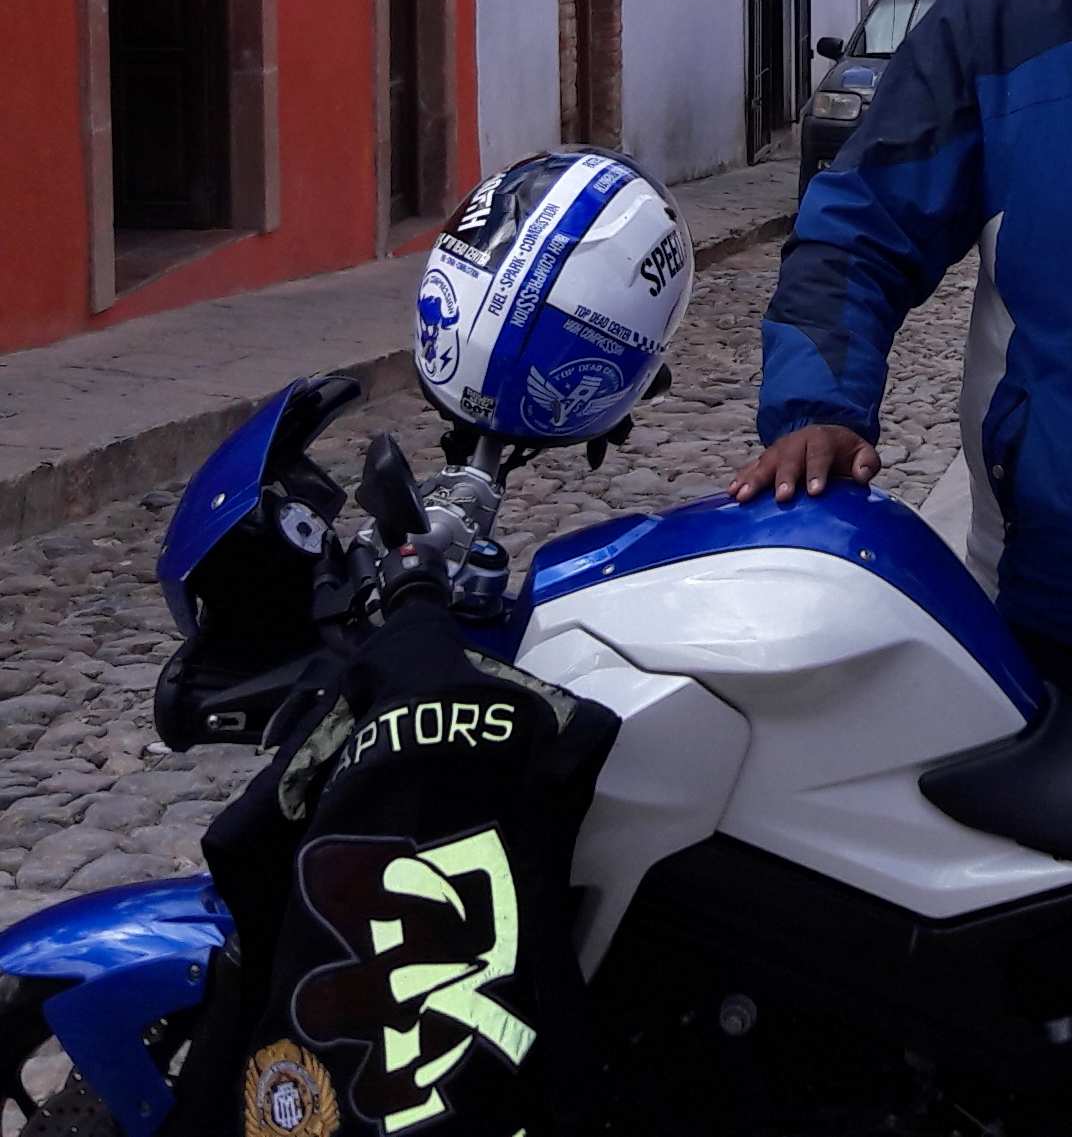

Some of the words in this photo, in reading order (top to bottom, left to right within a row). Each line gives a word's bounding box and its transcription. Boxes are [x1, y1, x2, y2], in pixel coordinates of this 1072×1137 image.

[487, 293, 508, 317] FUEL
[499, 255, 527, 290] SPARK
[509, 252, 557, 328] COMPRESSION
[332, 701, 515, 782] APTORS
